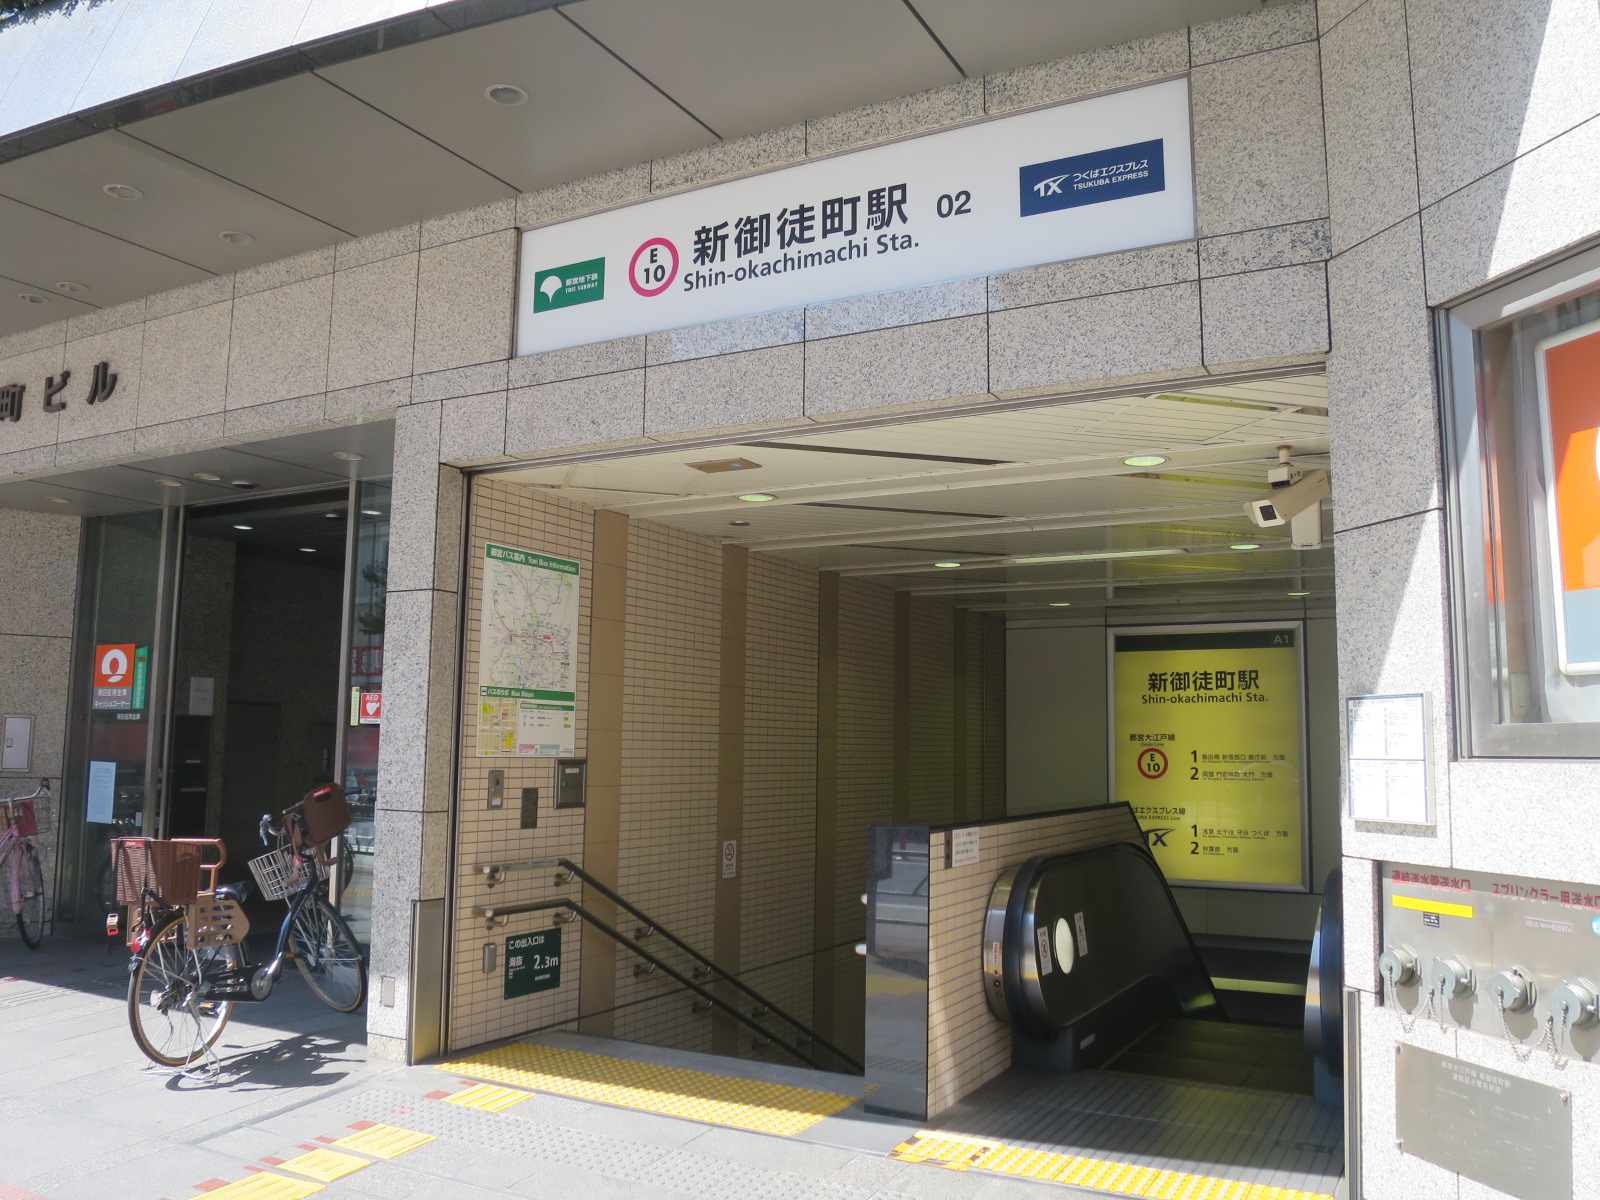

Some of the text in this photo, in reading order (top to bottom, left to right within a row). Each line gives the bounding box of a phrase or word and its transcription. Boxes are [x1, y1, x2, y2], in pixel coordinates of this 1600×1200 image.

[1073, 160, 1148, 182] つくばエクスプレス
[1034, 174, 1071, 198] TX
[1073, 170, 1148, 190] TSUKUBA EXPRESS
[692, 182, 972, 266] 新御徒町駅 02
[650, 248, 658, 264] E
[683, 234, 920, 292] Shin-okachimachi Sta.
[566, 273, 598, 286] 都営地下鉄
[644, 264, 666, 284] 10
[565, 282, 598, 294] TOEI SUBWAY
[528, 556, 538, 565] Toei
[539, 559, 548, 568] Bus
[549, 562, 576, 572] Information
[1273, 634, 1289, 644] A1
[1148, 670, 1260, 692] 新御徒町駅
[1142, 692, 1268, 704] Shin-okachimachi Sta.
[1130, 733, 1175, 742] 都営大江戸線
[1150, 754, 1155, 762] E
[1190, 750, 1197, 763] 1
[1147, 763, 1160, 772] 10
[1190, 767, 1199, 780] 2
[1191, 824, 1198, 837] 1
[1190, 842, 1199, 854] 2
[508, 935, 545, 950] この出入口は
[508, 954, 559, 969] 海抜 2.3m
